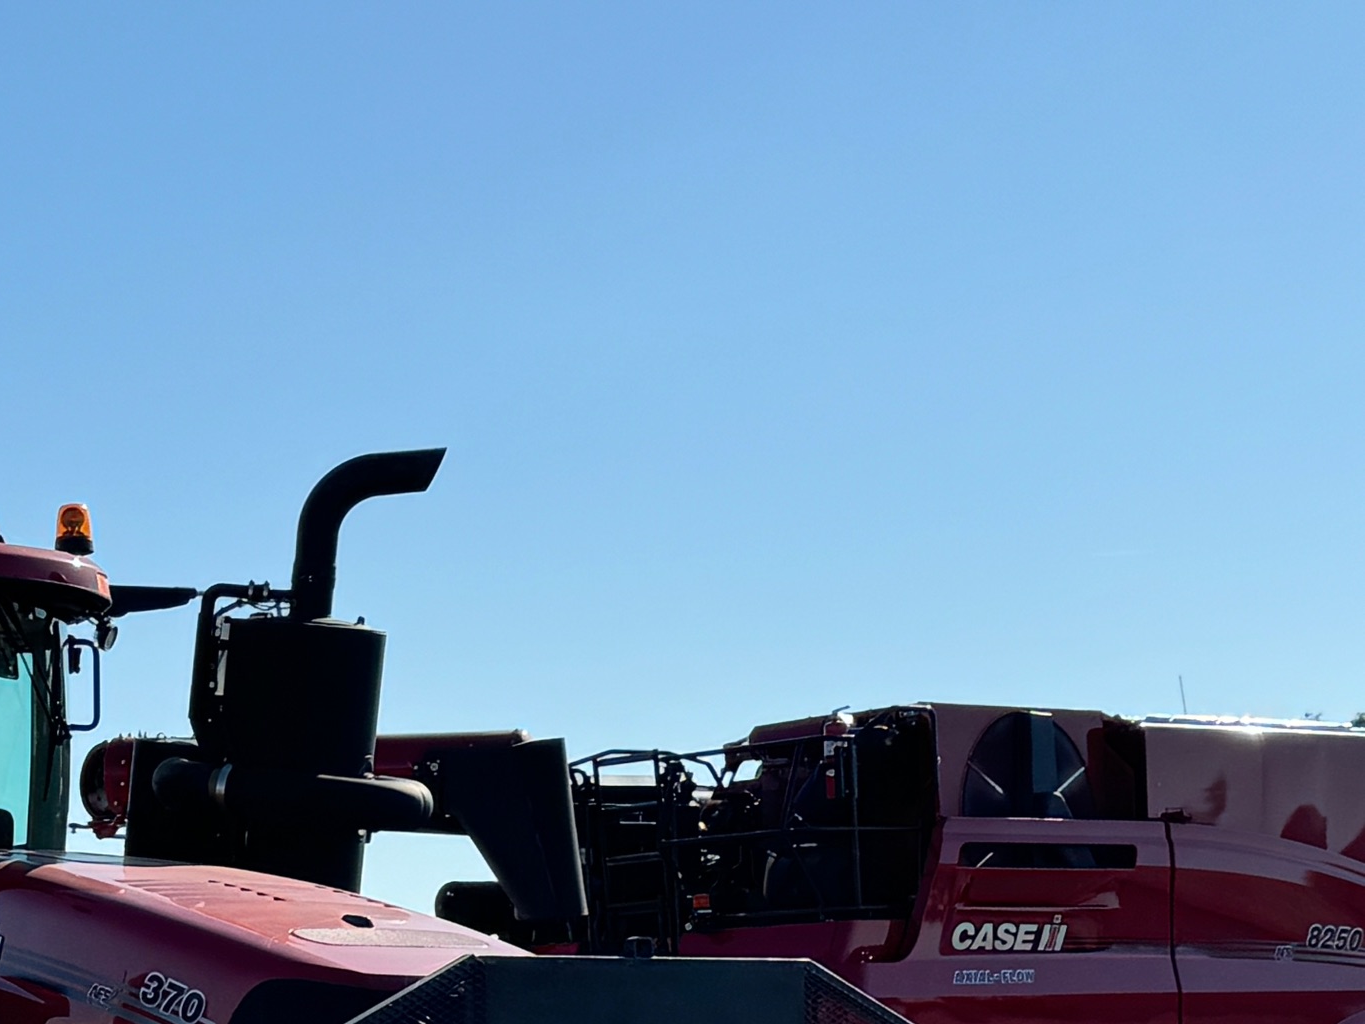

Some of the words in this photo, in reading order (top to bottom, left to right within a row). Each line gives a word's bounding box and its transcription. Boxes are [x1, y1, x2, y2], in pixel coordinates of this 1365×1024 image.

[951, 921, 1039, 951] CASE
[1306, 923, 1363, 951] 8250
[139, 971, 207, 1024] 370
